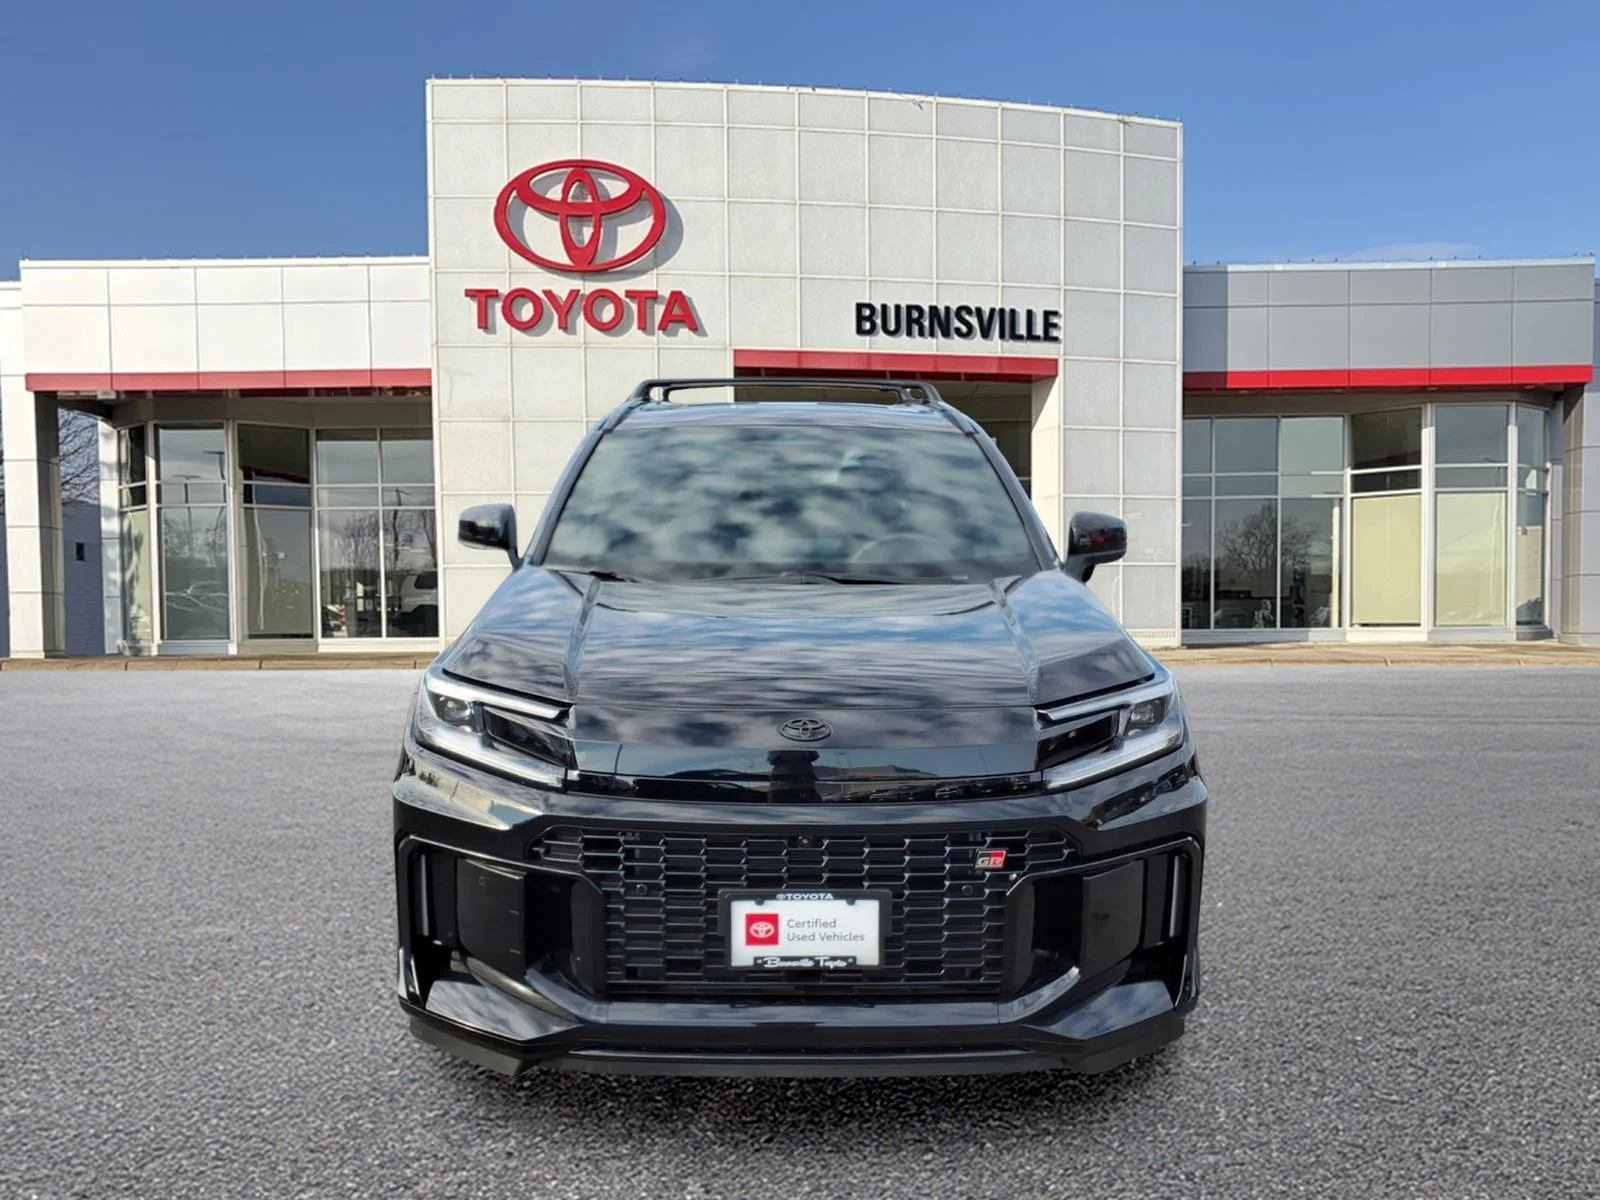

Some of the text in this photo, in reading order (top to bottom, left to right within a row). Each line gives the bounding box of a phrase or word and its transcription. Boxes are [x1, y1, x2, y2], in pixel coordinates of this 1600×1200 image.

[464, 287, 699, 332] TOYOTA
[855, 302, 1062, 343] BURNSVILLE
[786, 918, 837, 929] Certified
[787, 931, 865, 942] Used Vehicles
